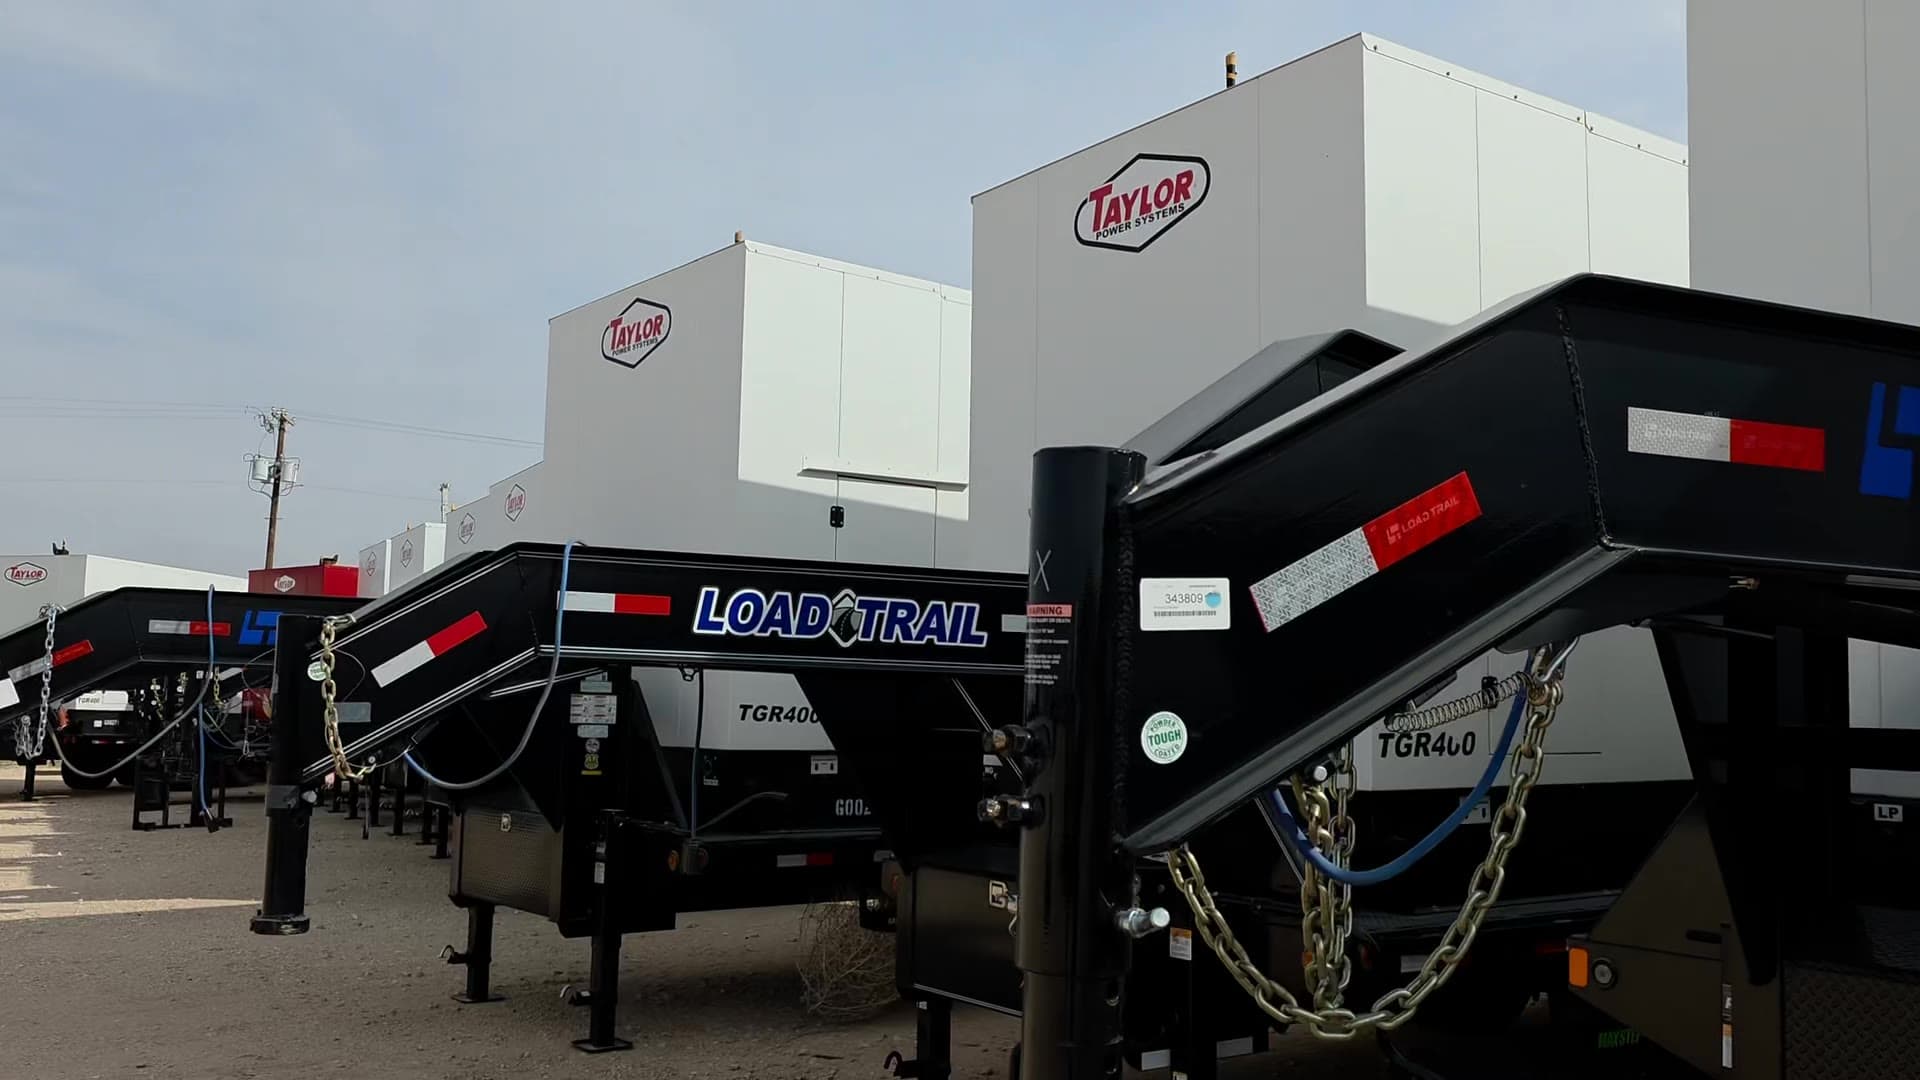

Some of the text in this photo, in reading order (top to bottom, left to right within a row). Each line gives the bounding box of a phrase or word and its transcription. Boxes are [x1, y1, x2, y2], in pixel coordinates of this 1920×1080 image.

[1088, 169, 1194, 233] TAYLOR
[1095, 202, 1185, 241] POWER SYSTEMS
[610, 313, 664, 351] TAYLOR
[1401, 496, 1460, 533] LOAD TRAIL
[10, 567, 43, 578] TAYLOR
[1029, 605, 1063, 616] ARNING
[1165, 593, 1204, 604] 343809
[693, 587, 988, 647] LOAD TRAIL
[1148, 729, 1182, 747] TOUGH
[1378, 731, 1476, 758] TGR400
[1878, 806, 1899, 819] LP
